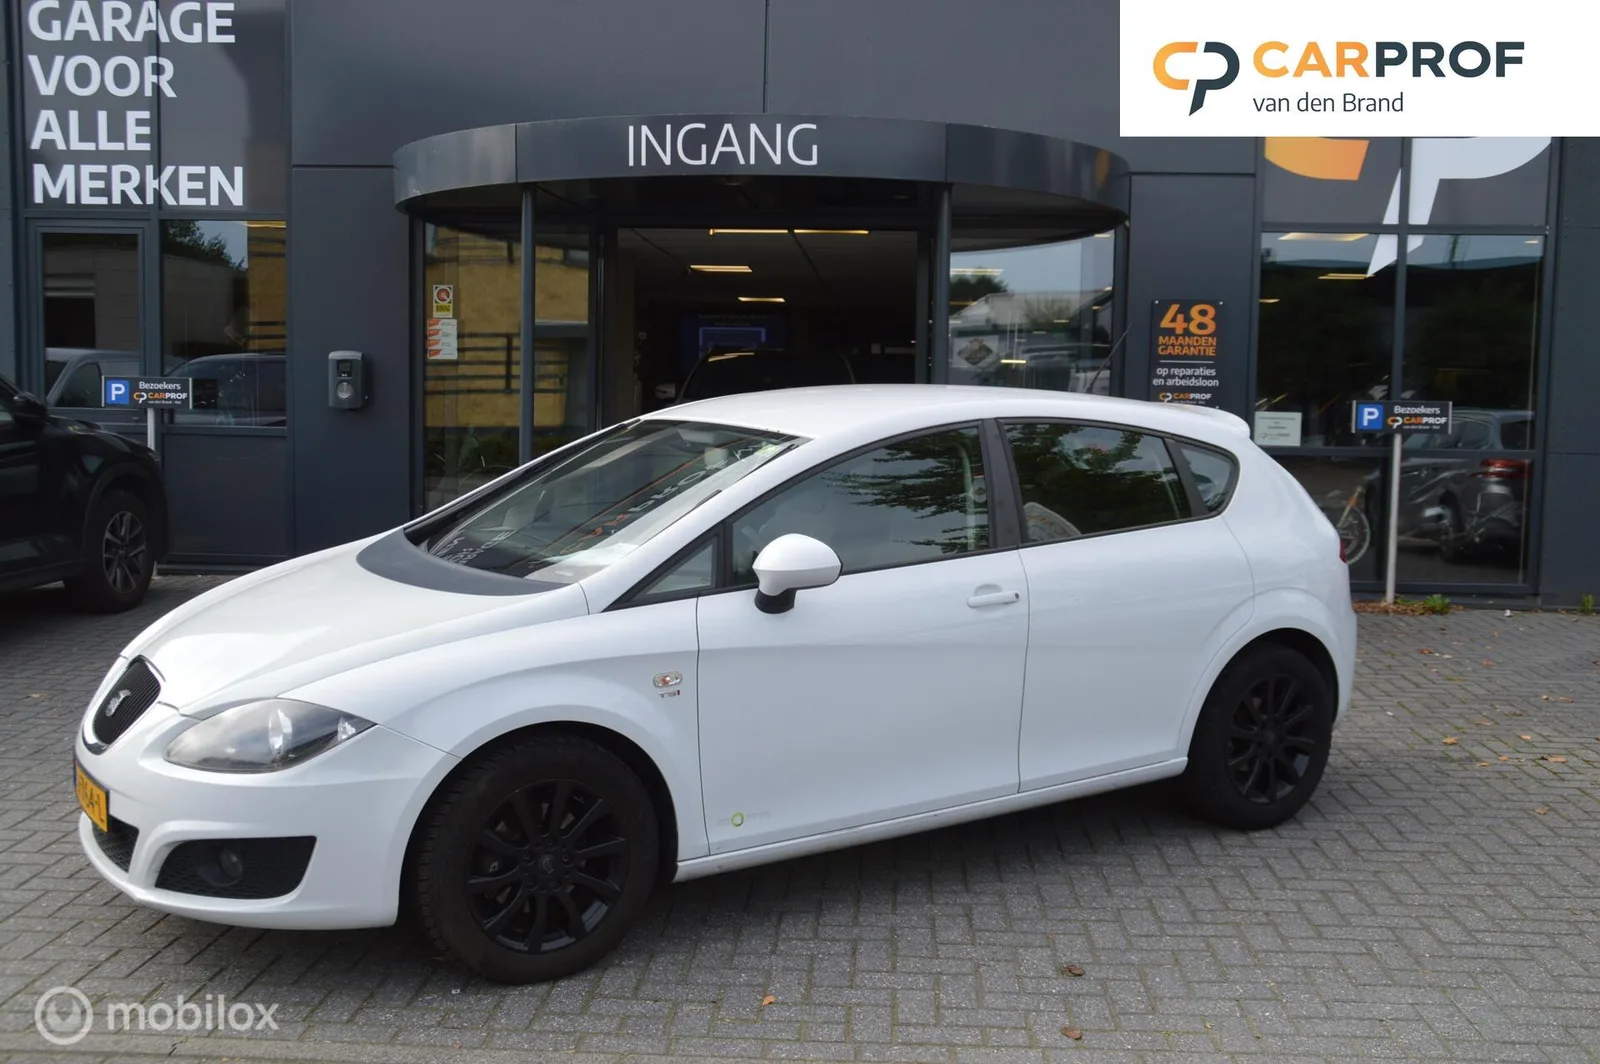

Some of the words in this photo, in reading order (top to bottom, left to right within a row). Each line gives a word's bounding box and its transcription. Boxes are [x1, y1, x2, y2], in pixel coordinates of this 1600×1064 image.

[28, 0, 236, 43] GARAGE
[27, 54, 178, 98] VOOR
[30, 109, 152, 151] ALLE
[628, 122, 818, 167] INGANG
[33, 163, 244, 207] MERKEN
[1159, 303, 1217, 335] 48
[1158, 335, 1217, 347] MAANDEN
[1157, 345, 1217, 357] GARANTIE
[1156, 368, 1169, 377] op
[1170, 366, 1217, 378] reparaties
[138, 381, 182, 390] Bezoekers
[1152, 378, 1165, 387] en
[1166, 376, 1219, 387] arbeidsloon
[111, 383, 126, 401] P
[148, 392, 188, 400] CARPROF
[1173, 392, 1212, 400] CARPROF
[1393, 405, 1441, 414] Bezoekers
[1362, 407, 1380, 427] P
[1404, 416, 1447, 424] CARPROF
